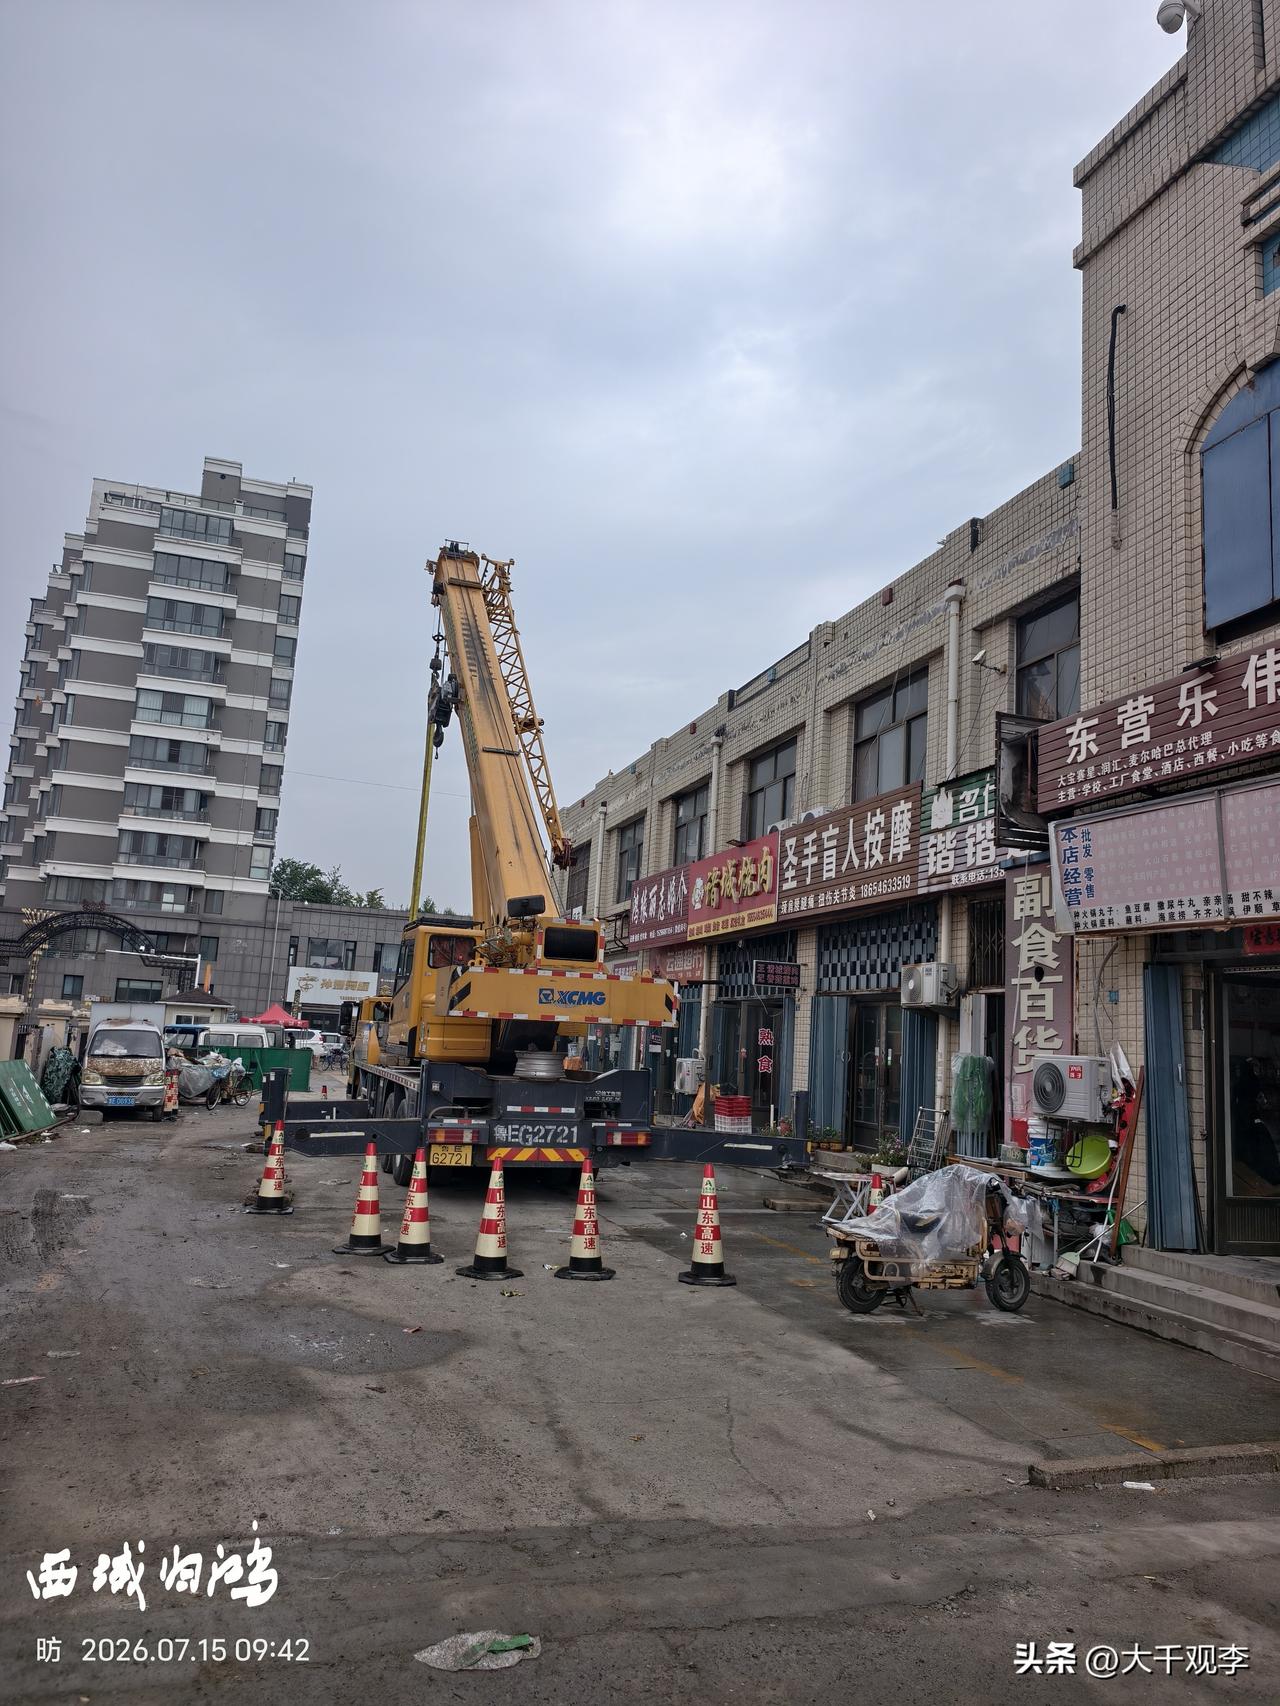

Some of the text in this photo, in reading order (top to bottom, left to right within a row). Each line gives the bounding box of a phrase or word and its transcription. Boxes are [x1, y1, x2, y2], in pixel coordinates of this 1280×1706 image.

[782, 799, 913, 891] 圣手盲人按摩
[1060, 827, 1083, 907] 本店经营
[1080, 828, 1096, 899] 批发 零售
[556, 990, 606, 1006] XCMG
[1011, 872, 1065, 1075] 副食百货
[757, 1028, 775, 1074] 熟食
[432, 1152, 468, 1165] G2721
[494, 1124, 578, 1146] 鲁EG2721
[583, 1191, 596, 1250] 山东高速
[700, 1196, 714, 1256] 山东高速
